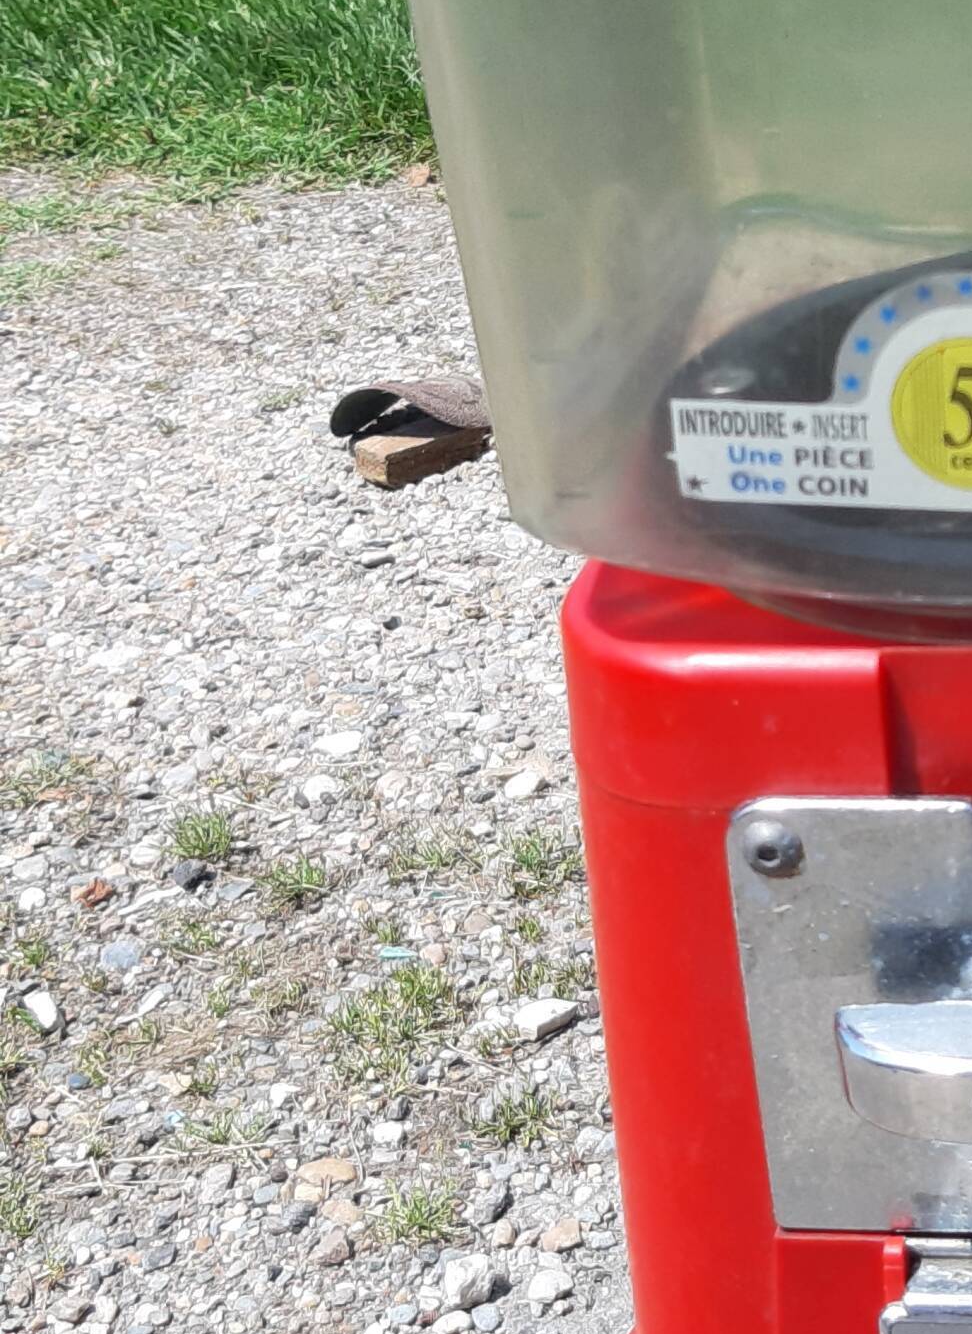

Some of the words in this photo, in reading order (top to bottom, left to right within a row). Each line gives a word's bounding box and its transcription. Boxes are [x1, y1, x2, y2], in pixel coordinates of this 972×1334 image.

[679, 409, 788, 439] INTRODUIRE
[812, 414, 869, 441] INSERT
[727, 445, 783, 465] Une
[794, 446, 874, 469] PIÈCE
[730, 471, 786, 494] One
[798, 475, 869, 498] COIN
